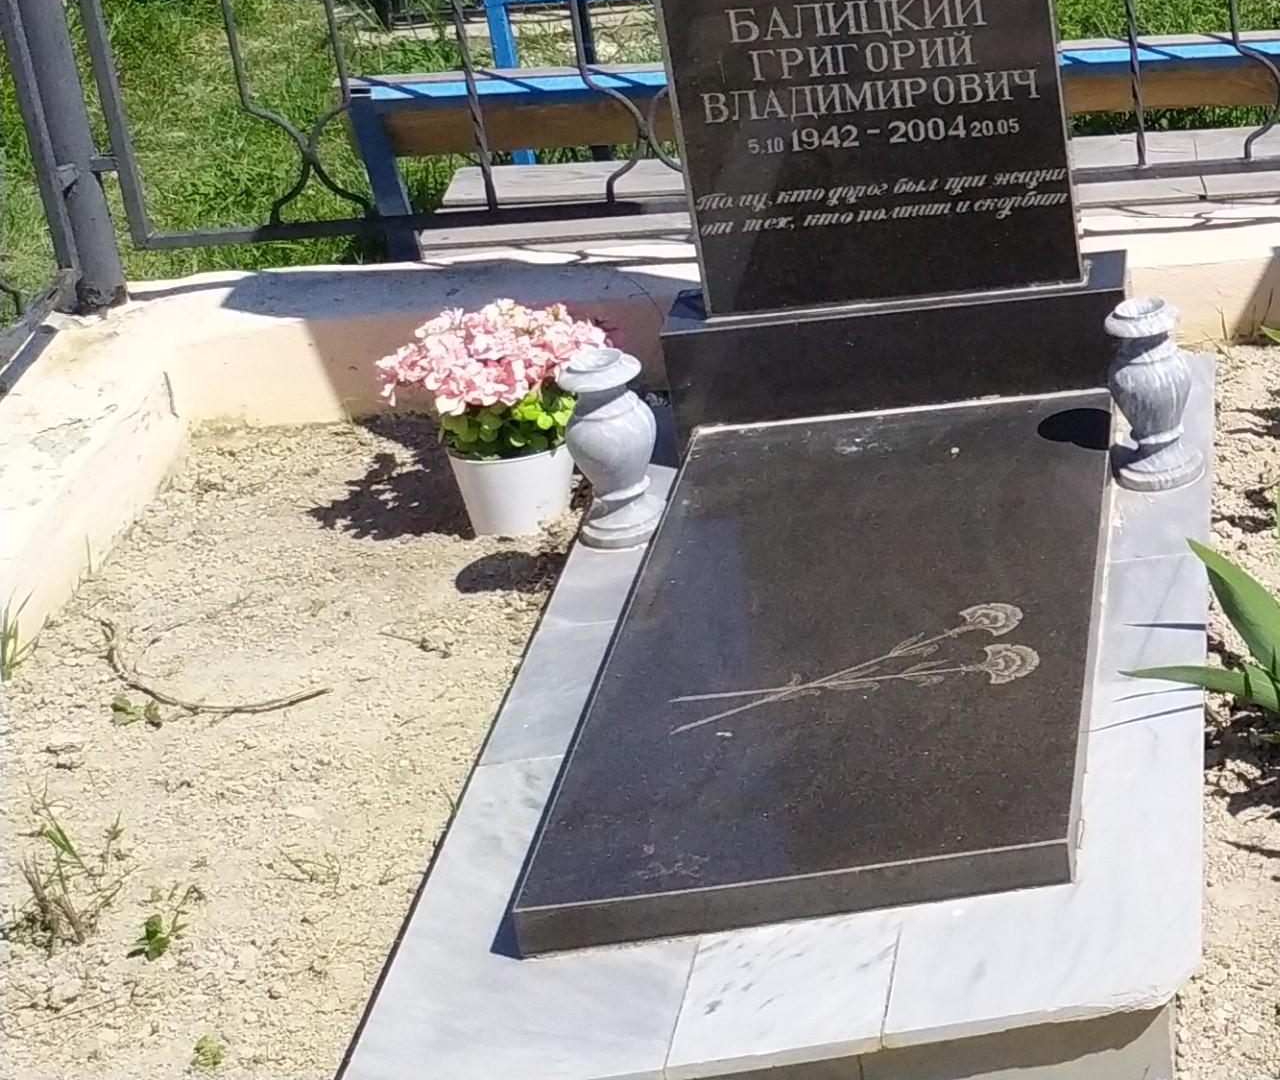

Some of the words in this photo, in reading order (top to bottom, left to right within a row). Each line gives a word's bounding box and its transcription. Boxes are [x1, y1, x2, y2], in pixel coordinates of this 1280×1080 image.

[748, 30, 977, 82] ГРИГОРИЙ
[701, 68, 1041, 125] ВЛАДИМИРОВИЧ
[791, 123, 860, 153] 1942
[887, 114, 967, 145] 2004
[970, 117, 1020, 138] 20.05
[775, 186, 826, 205] кто
[827, 182, 889, 207] дорог
[893, 176, 941, 195] был
[943, 173, 990, 197] при
[991, 167, 1068, 190] жизни
[701, 219, 734, 237] от
[740, 214, 796, 234] тех,
[803, 210, 855, 228] кто
[855, 202, 952, 224] помнит
[955, 199, 972, 214] и
[973, 189, 1069, 220] скорбит
